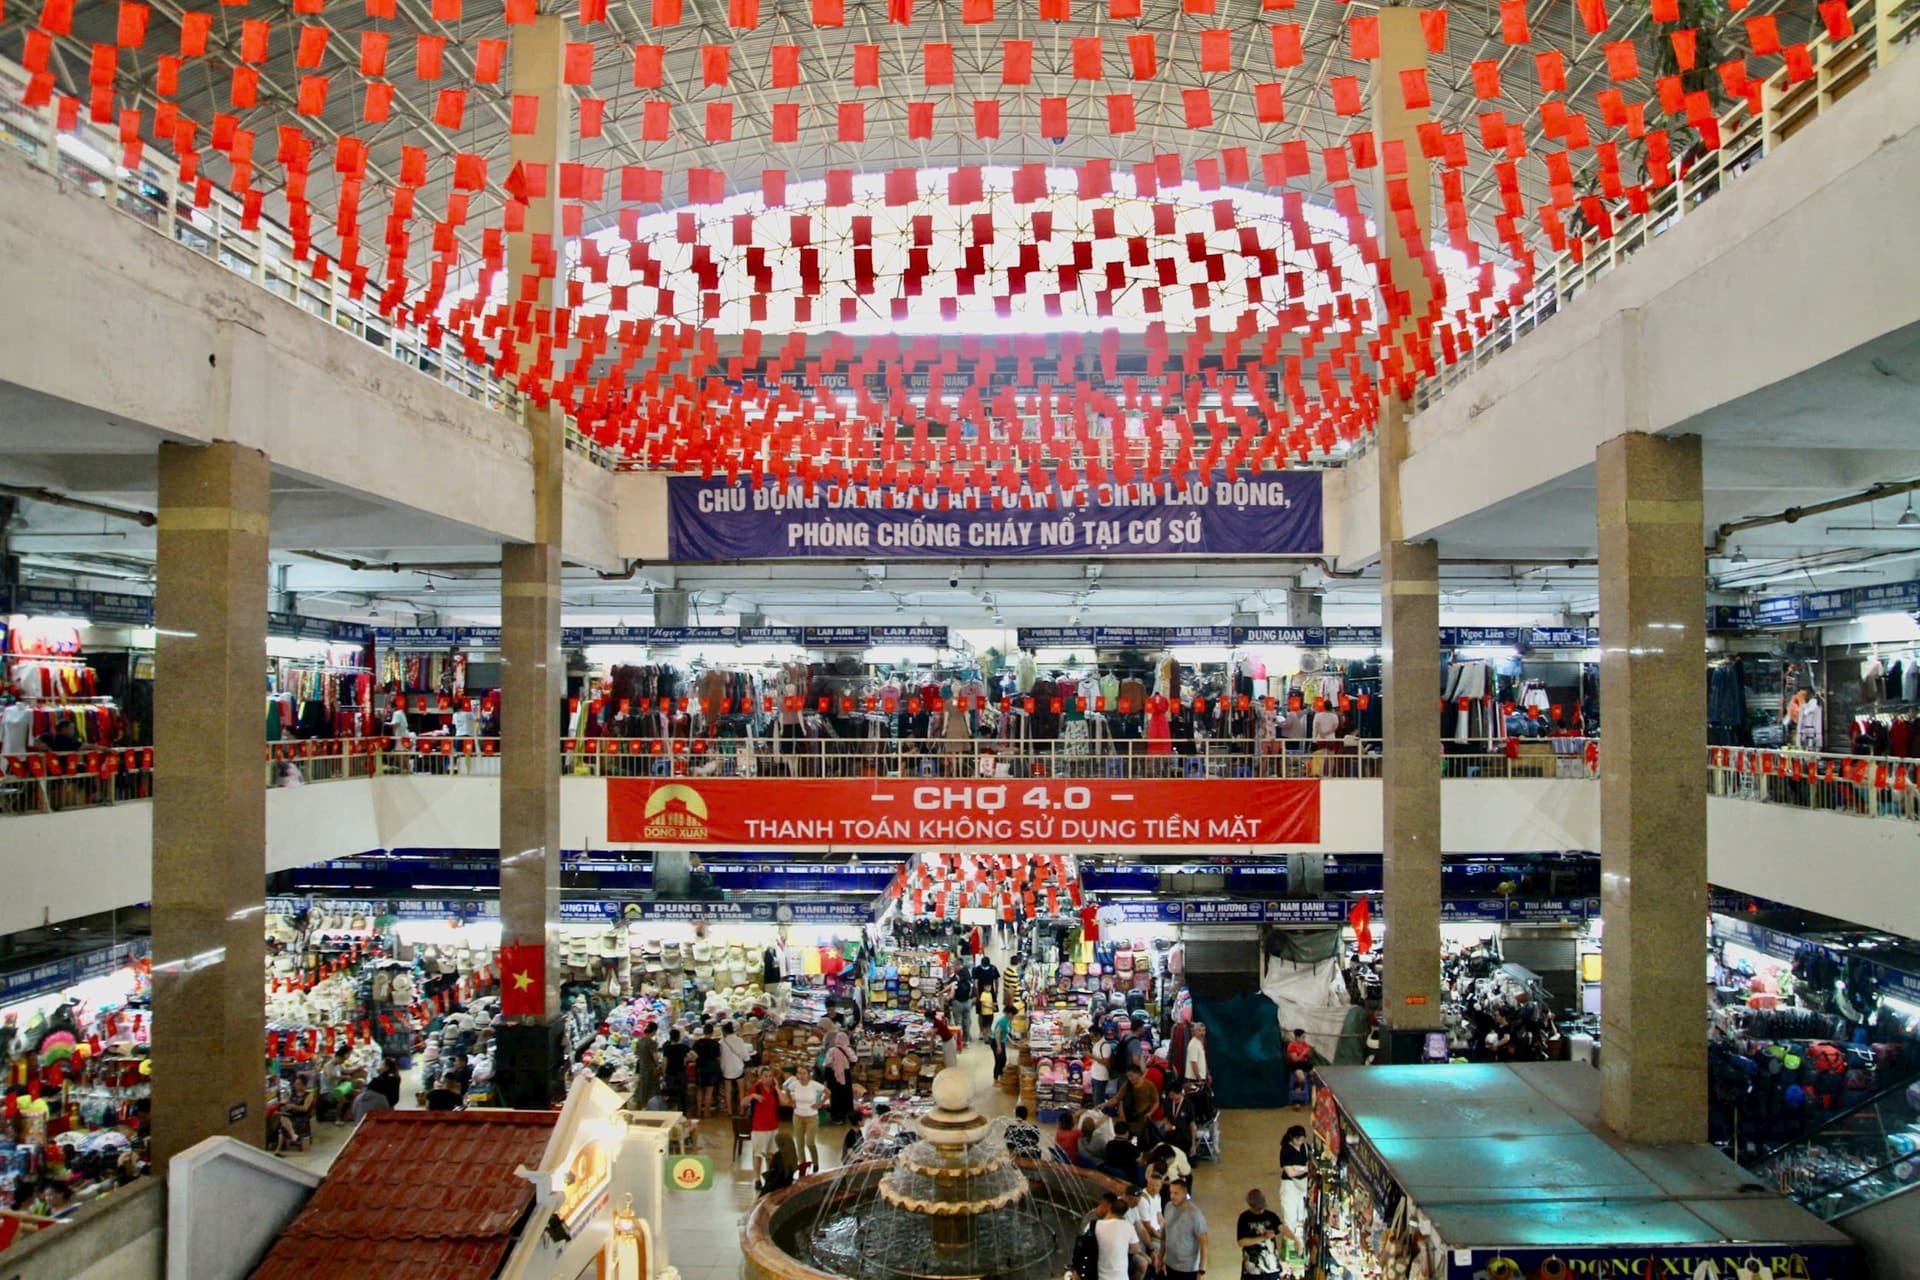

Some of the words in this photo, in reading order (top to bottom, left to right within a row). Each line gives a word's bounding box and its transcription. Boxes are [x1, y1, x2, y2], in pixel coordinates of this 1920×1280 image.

[698, 481, 745, 512] CHỦ
[1164, 482, 1209, 506] LAO
[1216, 477, 1292, 511] ĐỘNG,
[787, 516, 870, 547] PHÒNG
[877, 514, 961, 547] CHỐNG
[968, 517, 1033, 547] CHÁY
[1040, 512, 1076, 546] NỔ
[1082, 519, 1120, 550] TẠI
[1128, 518, 1163, 545] CƠ
[1169, 511, 1202, 544] SỞ
[1247, 630, 1277, 641] DUNG
[1278, 630, 1304, 641] LOAN
[1460, 629, 1484, 640] Ngọc
[913, 785, 1008, 815] CHỢ
[1022, 787, 1091, 810] 4.0
[744, 820, 833, 839] THANH
[840, 816, 915, 839] TOÁN
[919, 815, 1012, 839] KHÔNG
[1019, 813, 1054, 839] SỬ
[1061, 819, 1137, 843] DỤNG
[1143, 813, 1200, 839] TIỀN
[1207, 814, 1262, 843] MẶT
[654, 904, 702, 912] DUNG
[707, 902, 741, 912] TRÀ
[795, 904, 826, 914] THÀNH
[829, 904, 856, 914] PHÚC
